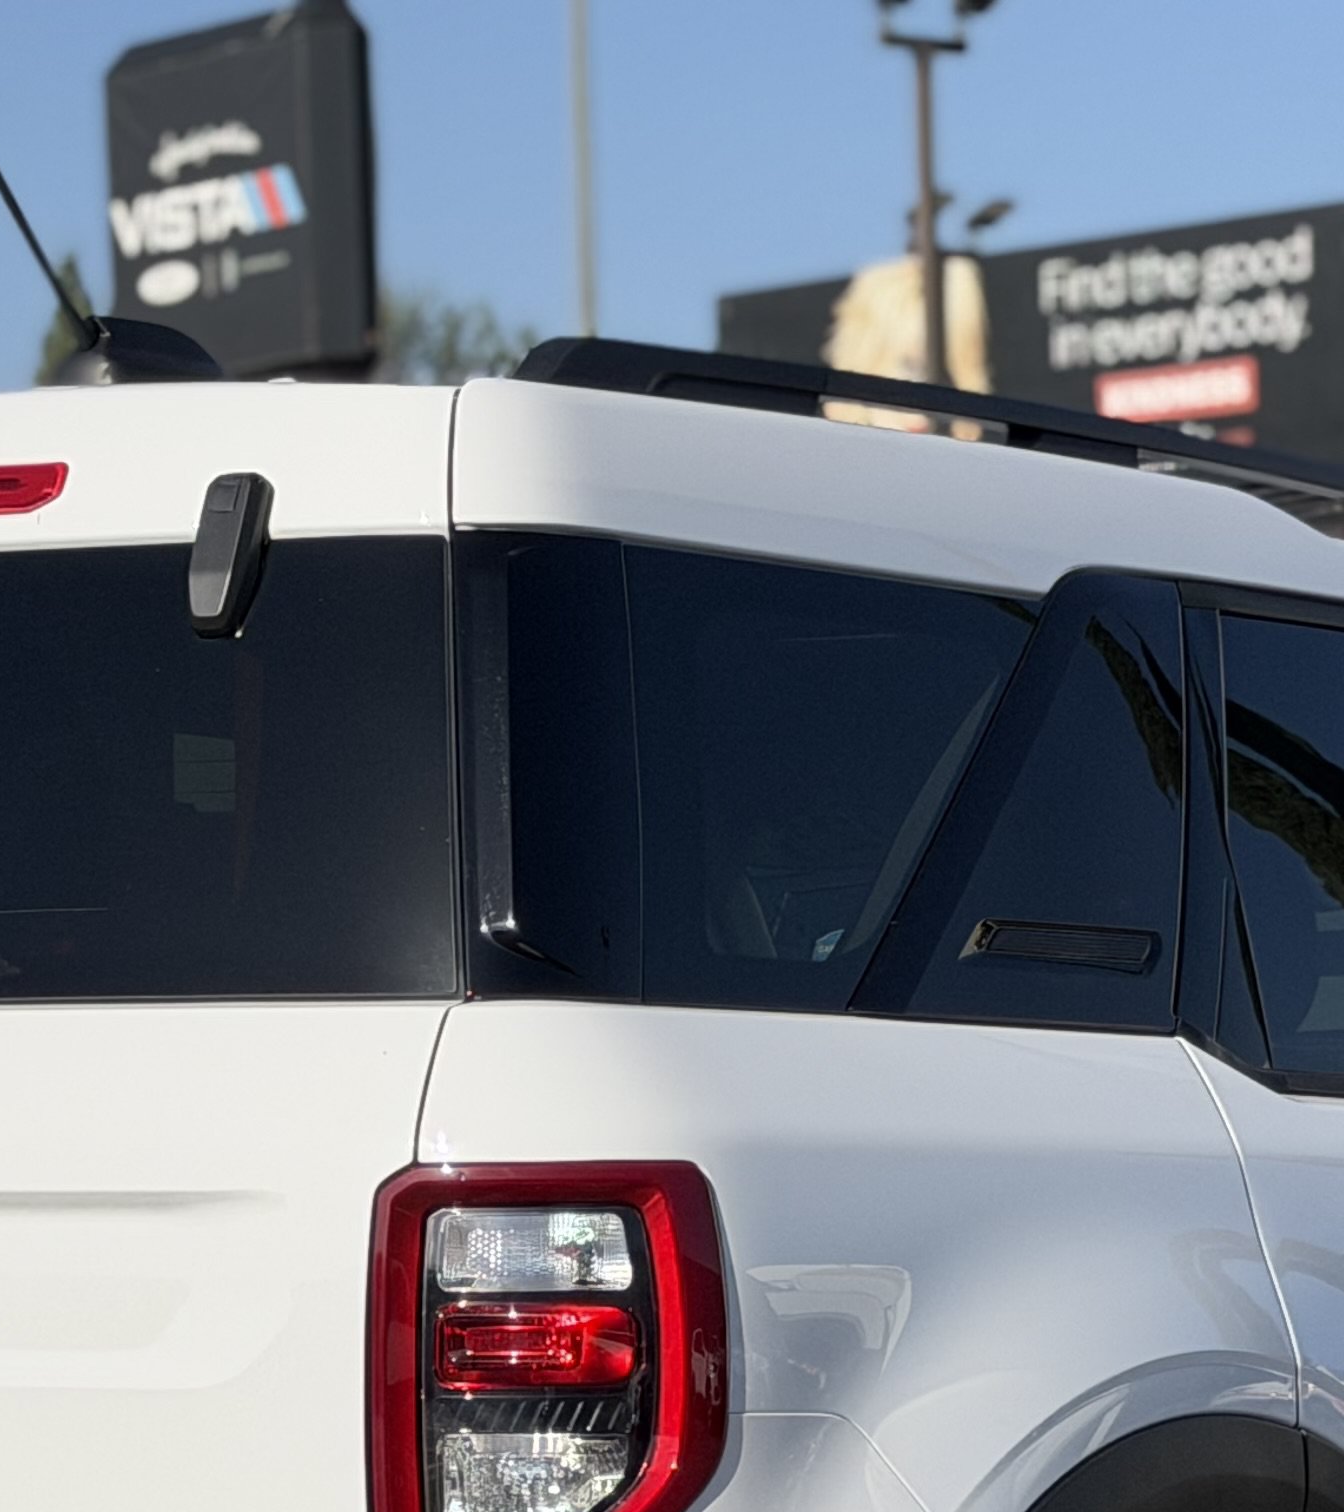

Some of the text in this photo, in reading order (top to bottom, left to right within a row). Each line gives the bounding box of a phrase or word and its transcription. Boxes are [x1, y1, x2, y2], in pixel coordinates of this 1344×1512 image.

[110, 174, 257, 259] VISTA
[1038, 223, 1314, 313] Find the good
[1049, 316, 1093, 370] in
